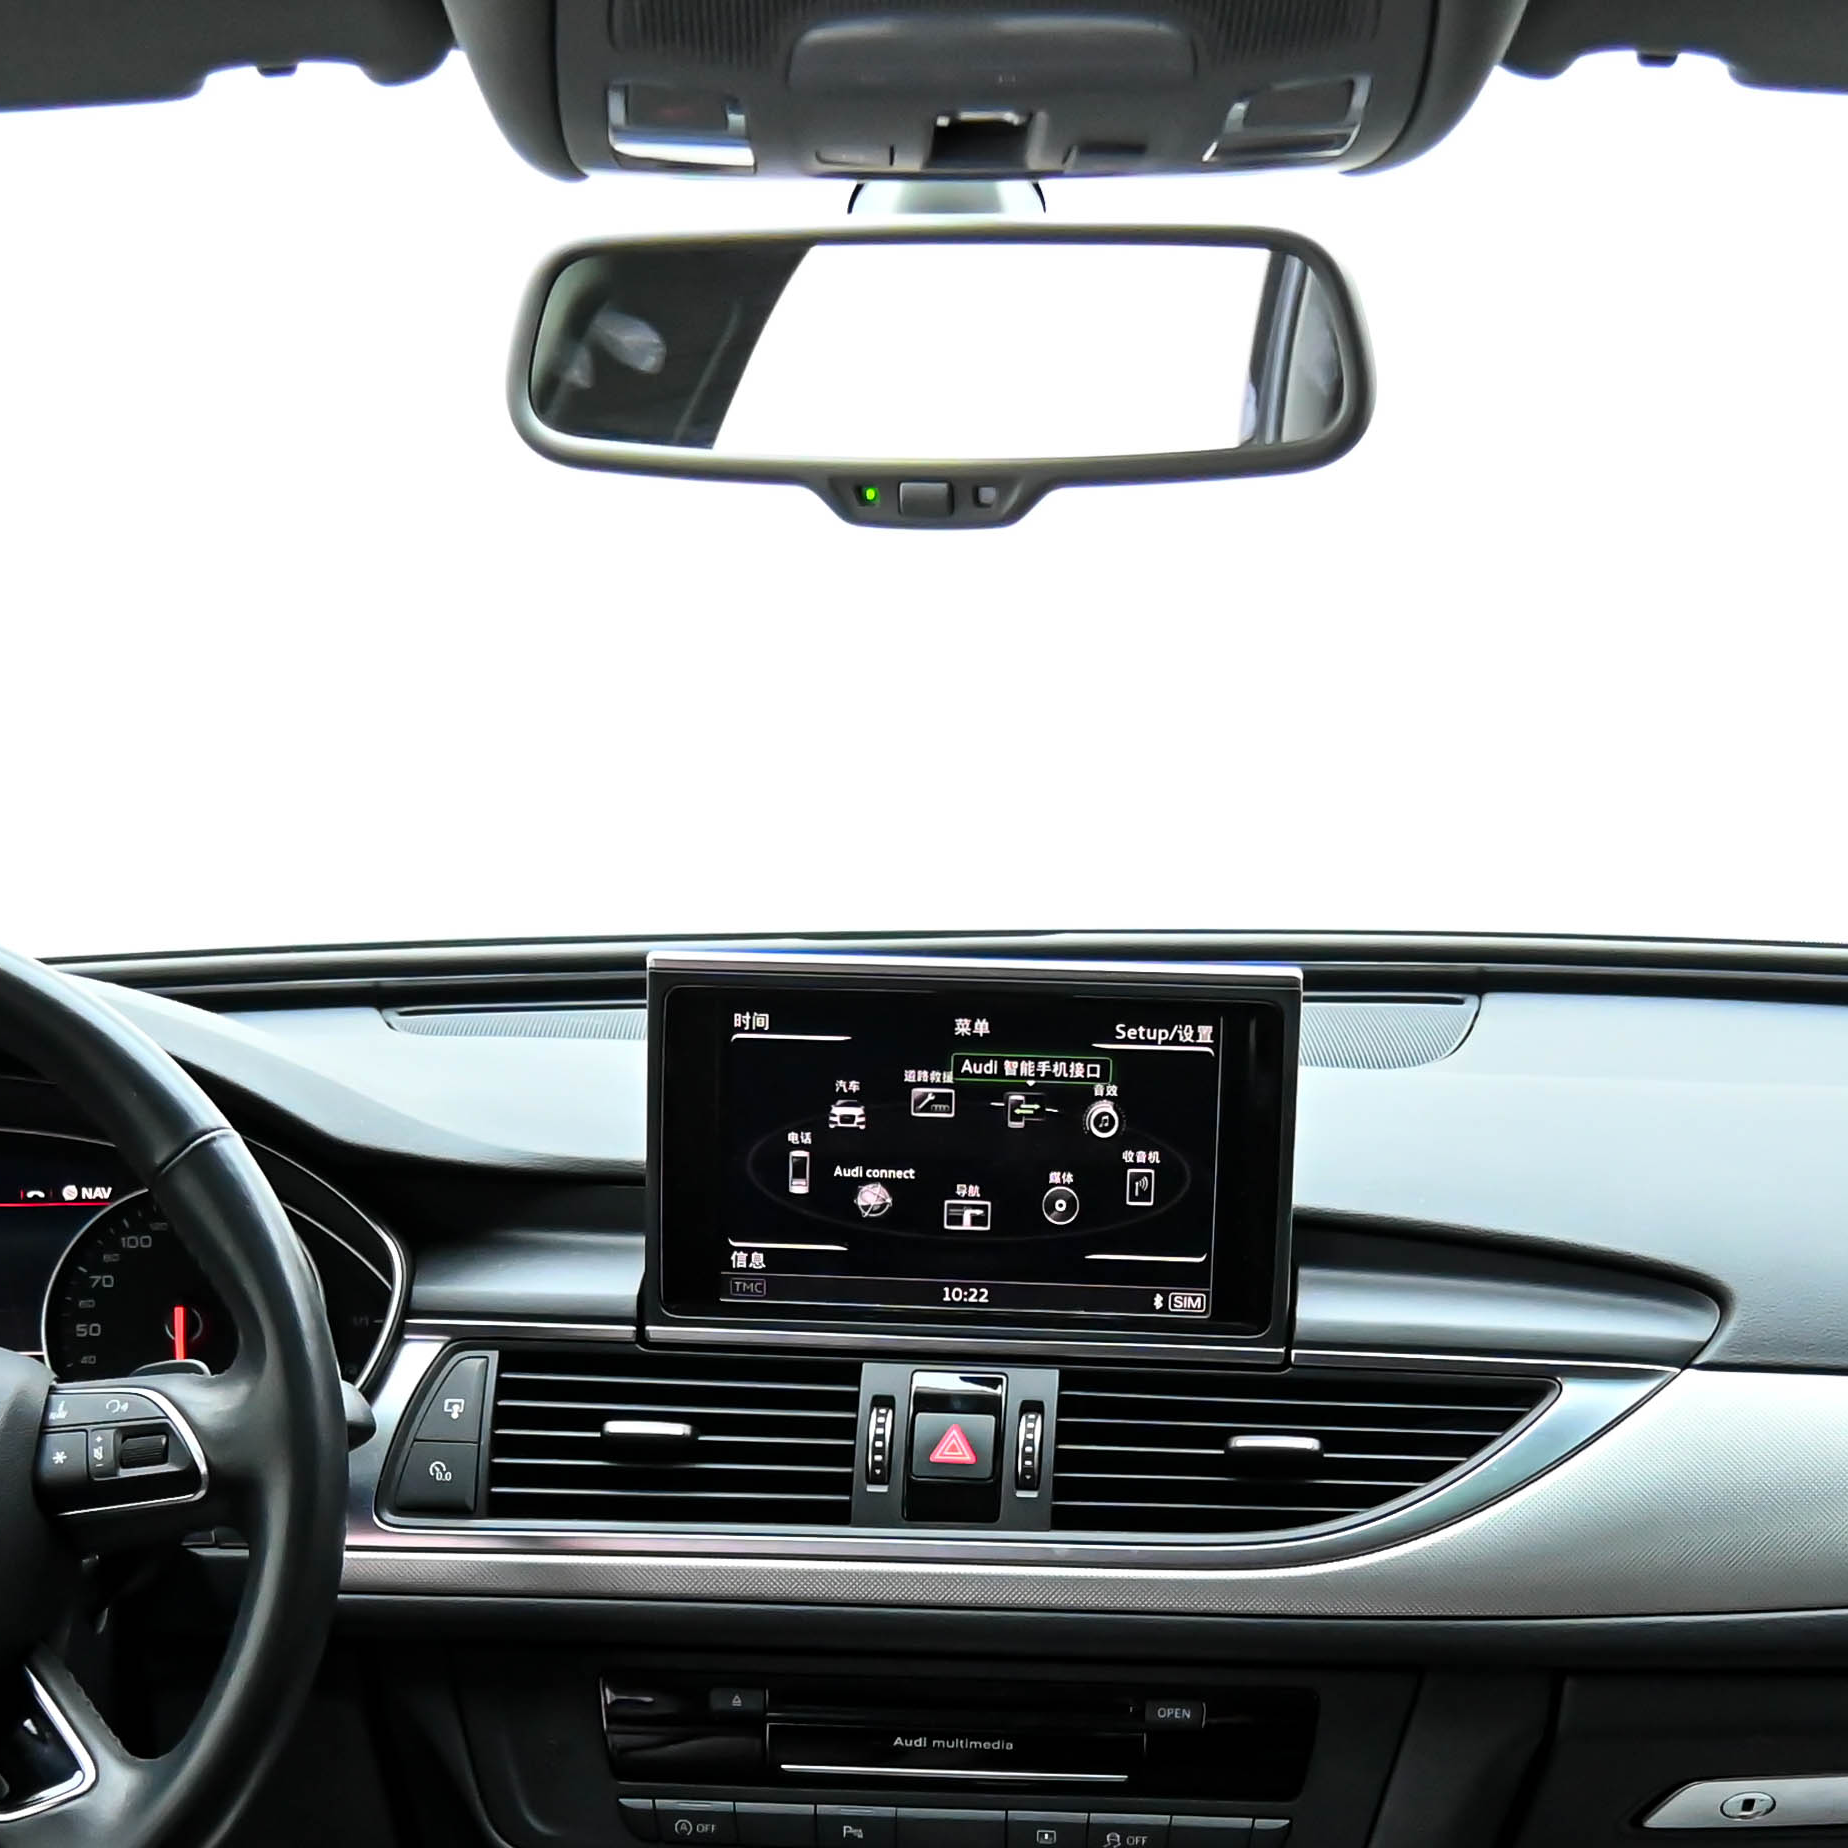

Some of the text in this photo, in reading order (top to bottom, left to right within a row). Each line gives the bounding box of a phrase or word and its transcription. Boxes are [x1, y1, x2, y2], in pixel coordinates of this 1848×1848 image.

[734, 1012, 769, 1030] 时间
[955, 1018, 990, 1036] 菜单
[1116, 1024, 1213, 1045] Setup/设置
[961, 1059, 1100, 1078] Audi 智能手机接口
[836, 1080, 859, 1092] 汽车
[1093, 1084, 1118, 1097] 音效
[788, 1132, 811, 1144] 电话
[1123, 1150, 1160, 1163] 收音机
[834, 1166, 915, 1179] Audi connect
[82, 1187, 112, 1199] NAV
[956, 1184, 980, 1197] 导航
[121, 1235, 152, 1249] 100
[731, 1251, 766, 1269] 信息
[89, 1275, 115, 1288] 70
[733, 1280, 763, 1293] TMC
[943, 1287, 988, 1302] 10:22
[1173, 1297, 1201, 1309] SIM
[75, 1322, 101, 1337] 50
[1158, 1708, 1190, 1718] OPEN
[893, 1737, 1013, 1750] Audi multimedia
[697, 1824, 715, 1832] OFF
[1127, 1836, 1147, 1845] OFF
